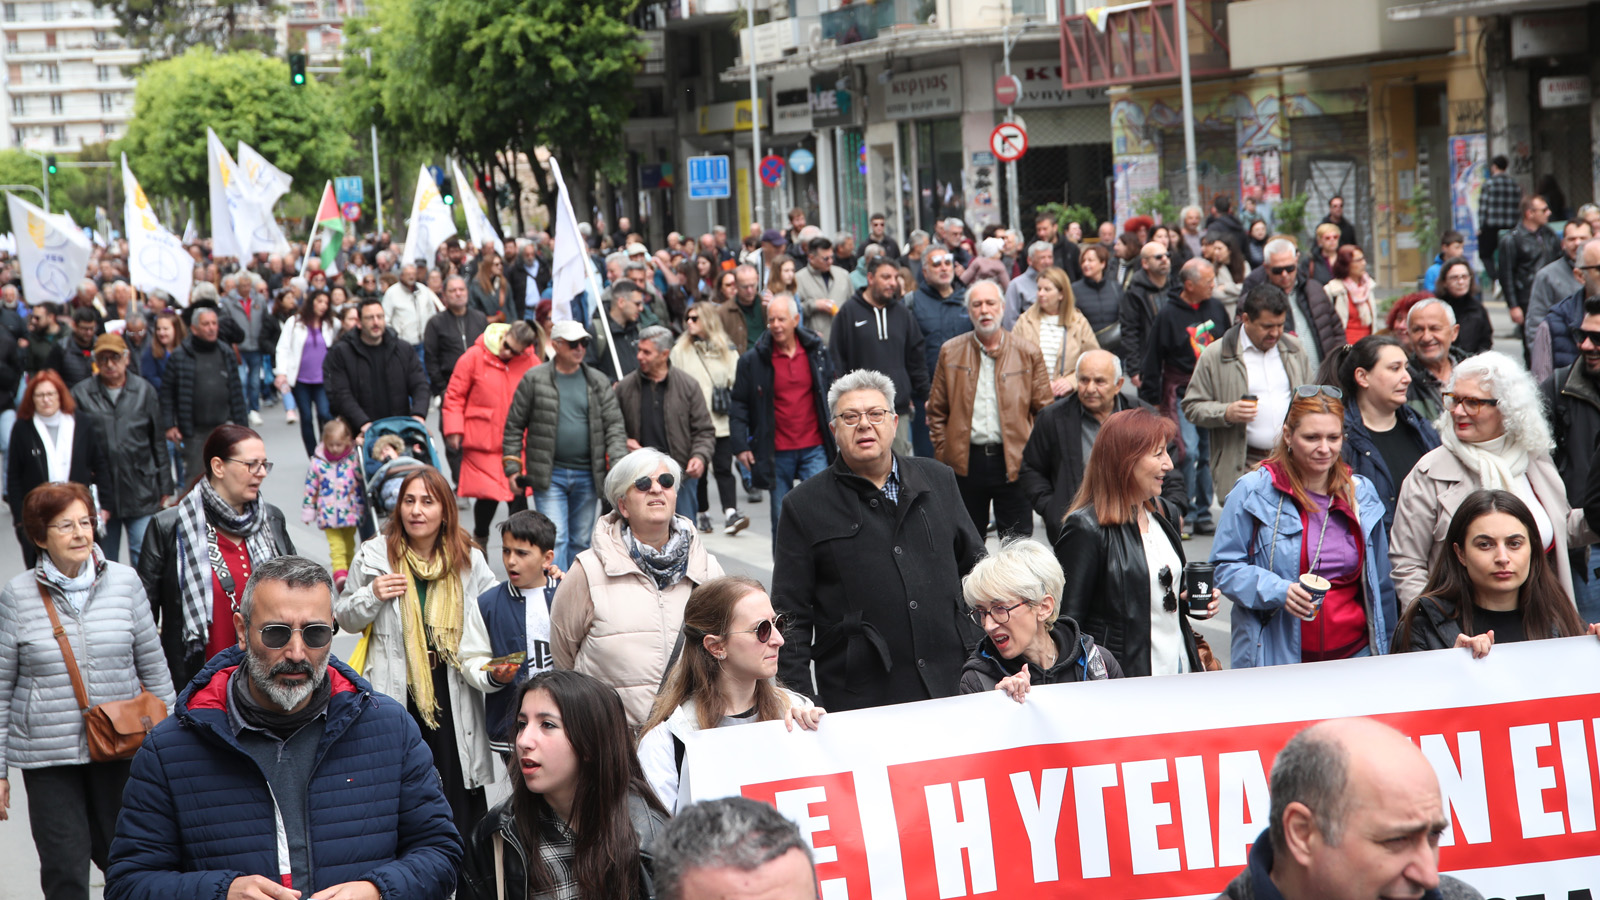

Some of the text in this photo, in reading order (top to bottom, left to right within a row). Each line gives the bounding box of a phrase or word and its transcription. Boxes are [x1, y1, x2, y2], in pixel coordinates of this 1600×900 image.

[924, 778, 997, 899] Η
[1009, 750, 1271, 883] ΥΓΕΙΑ
[1509, 718, 1600, 839] ΕΙ
